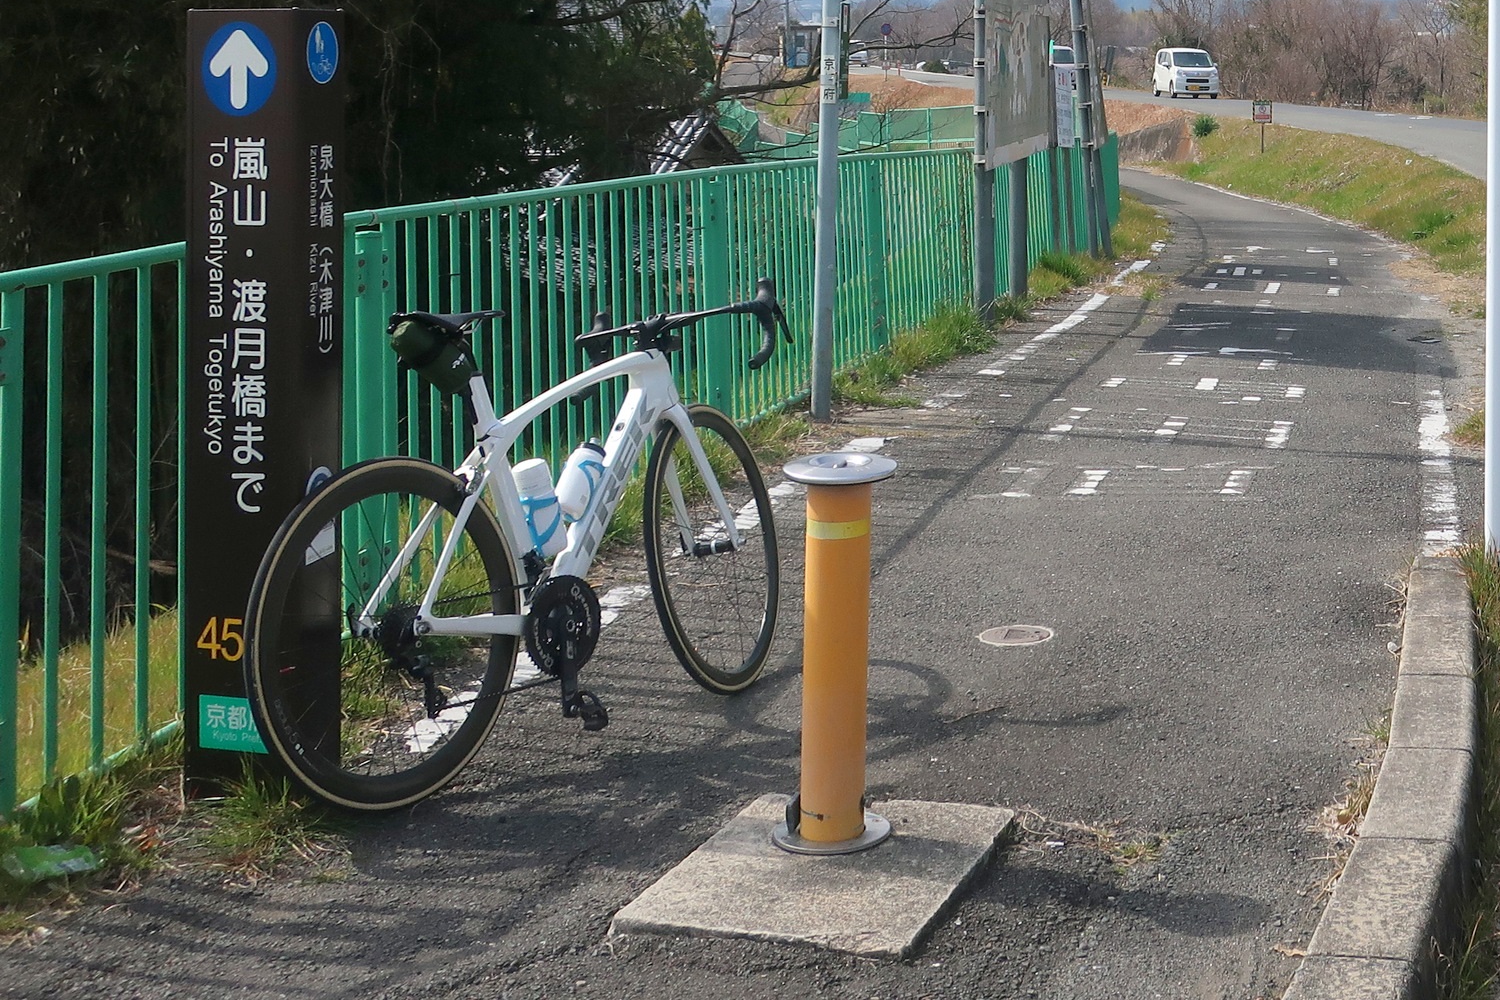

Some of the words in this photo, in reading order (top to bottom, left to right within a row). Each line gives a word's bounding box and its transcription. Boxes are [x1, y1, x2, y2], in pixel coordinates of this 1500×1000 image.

[823, 58, 836, 100] 京府
[208, 137, 229, 168] To
[309, 144, 319, 227] Izumiohashi
[319, 143, 334, 229] 泉大橋
[204, 181, 228, 319] Arashiyama
[309, 242, 319, 274] Kizu
[231, 136, 269, 514] 嵐山・渡月橋まで
[309, 281, 319, 318] River
[203, 333, 227, 456] Togetukyo
[573, 400, 657, 559] TREK
[197, 616, 245, 663] 45
[212, 729, 238, 742] Kyoto
